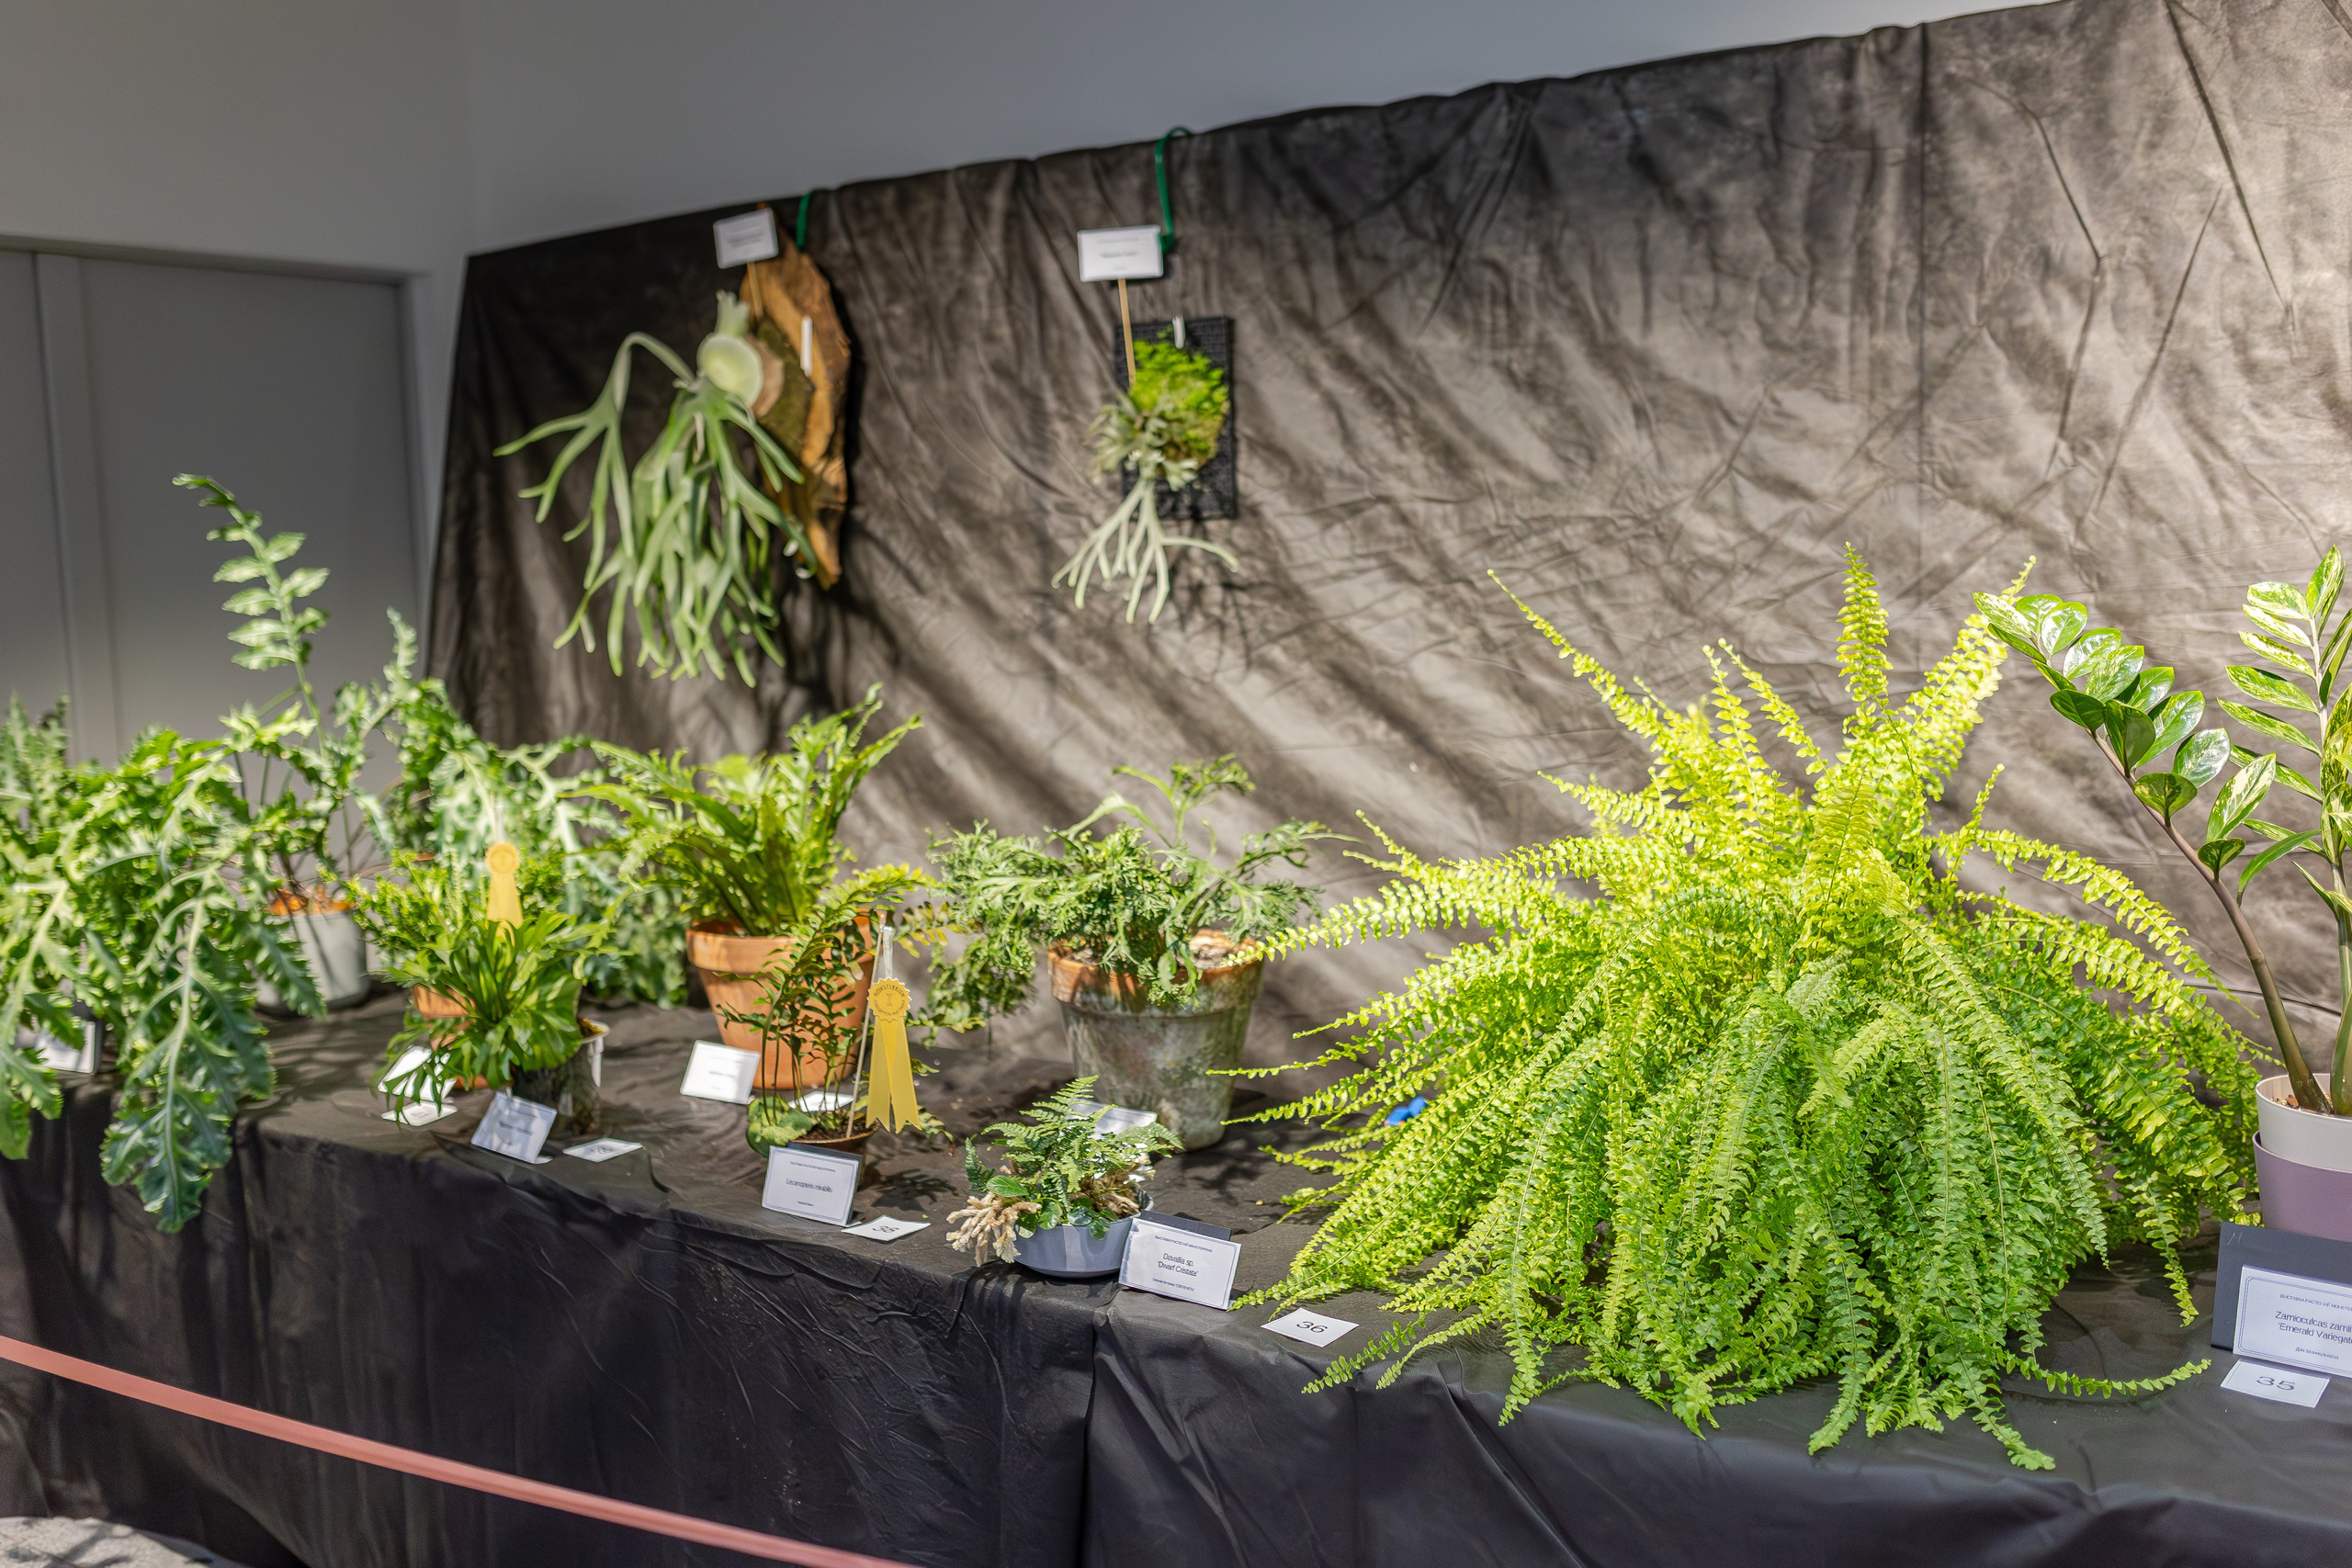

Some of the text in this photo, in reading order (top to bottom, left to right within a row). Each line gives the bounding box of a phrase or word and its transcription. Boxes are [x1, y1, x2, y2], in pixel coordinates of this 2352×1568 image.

[1163, 1253, 1185, 1264] Davallia
[1296, 1321, 1328, 1333] 36
[2275, 1311, 2352, 1333] Zamioculcas zamii
[2256, 1376, 2295, 1391] 35
